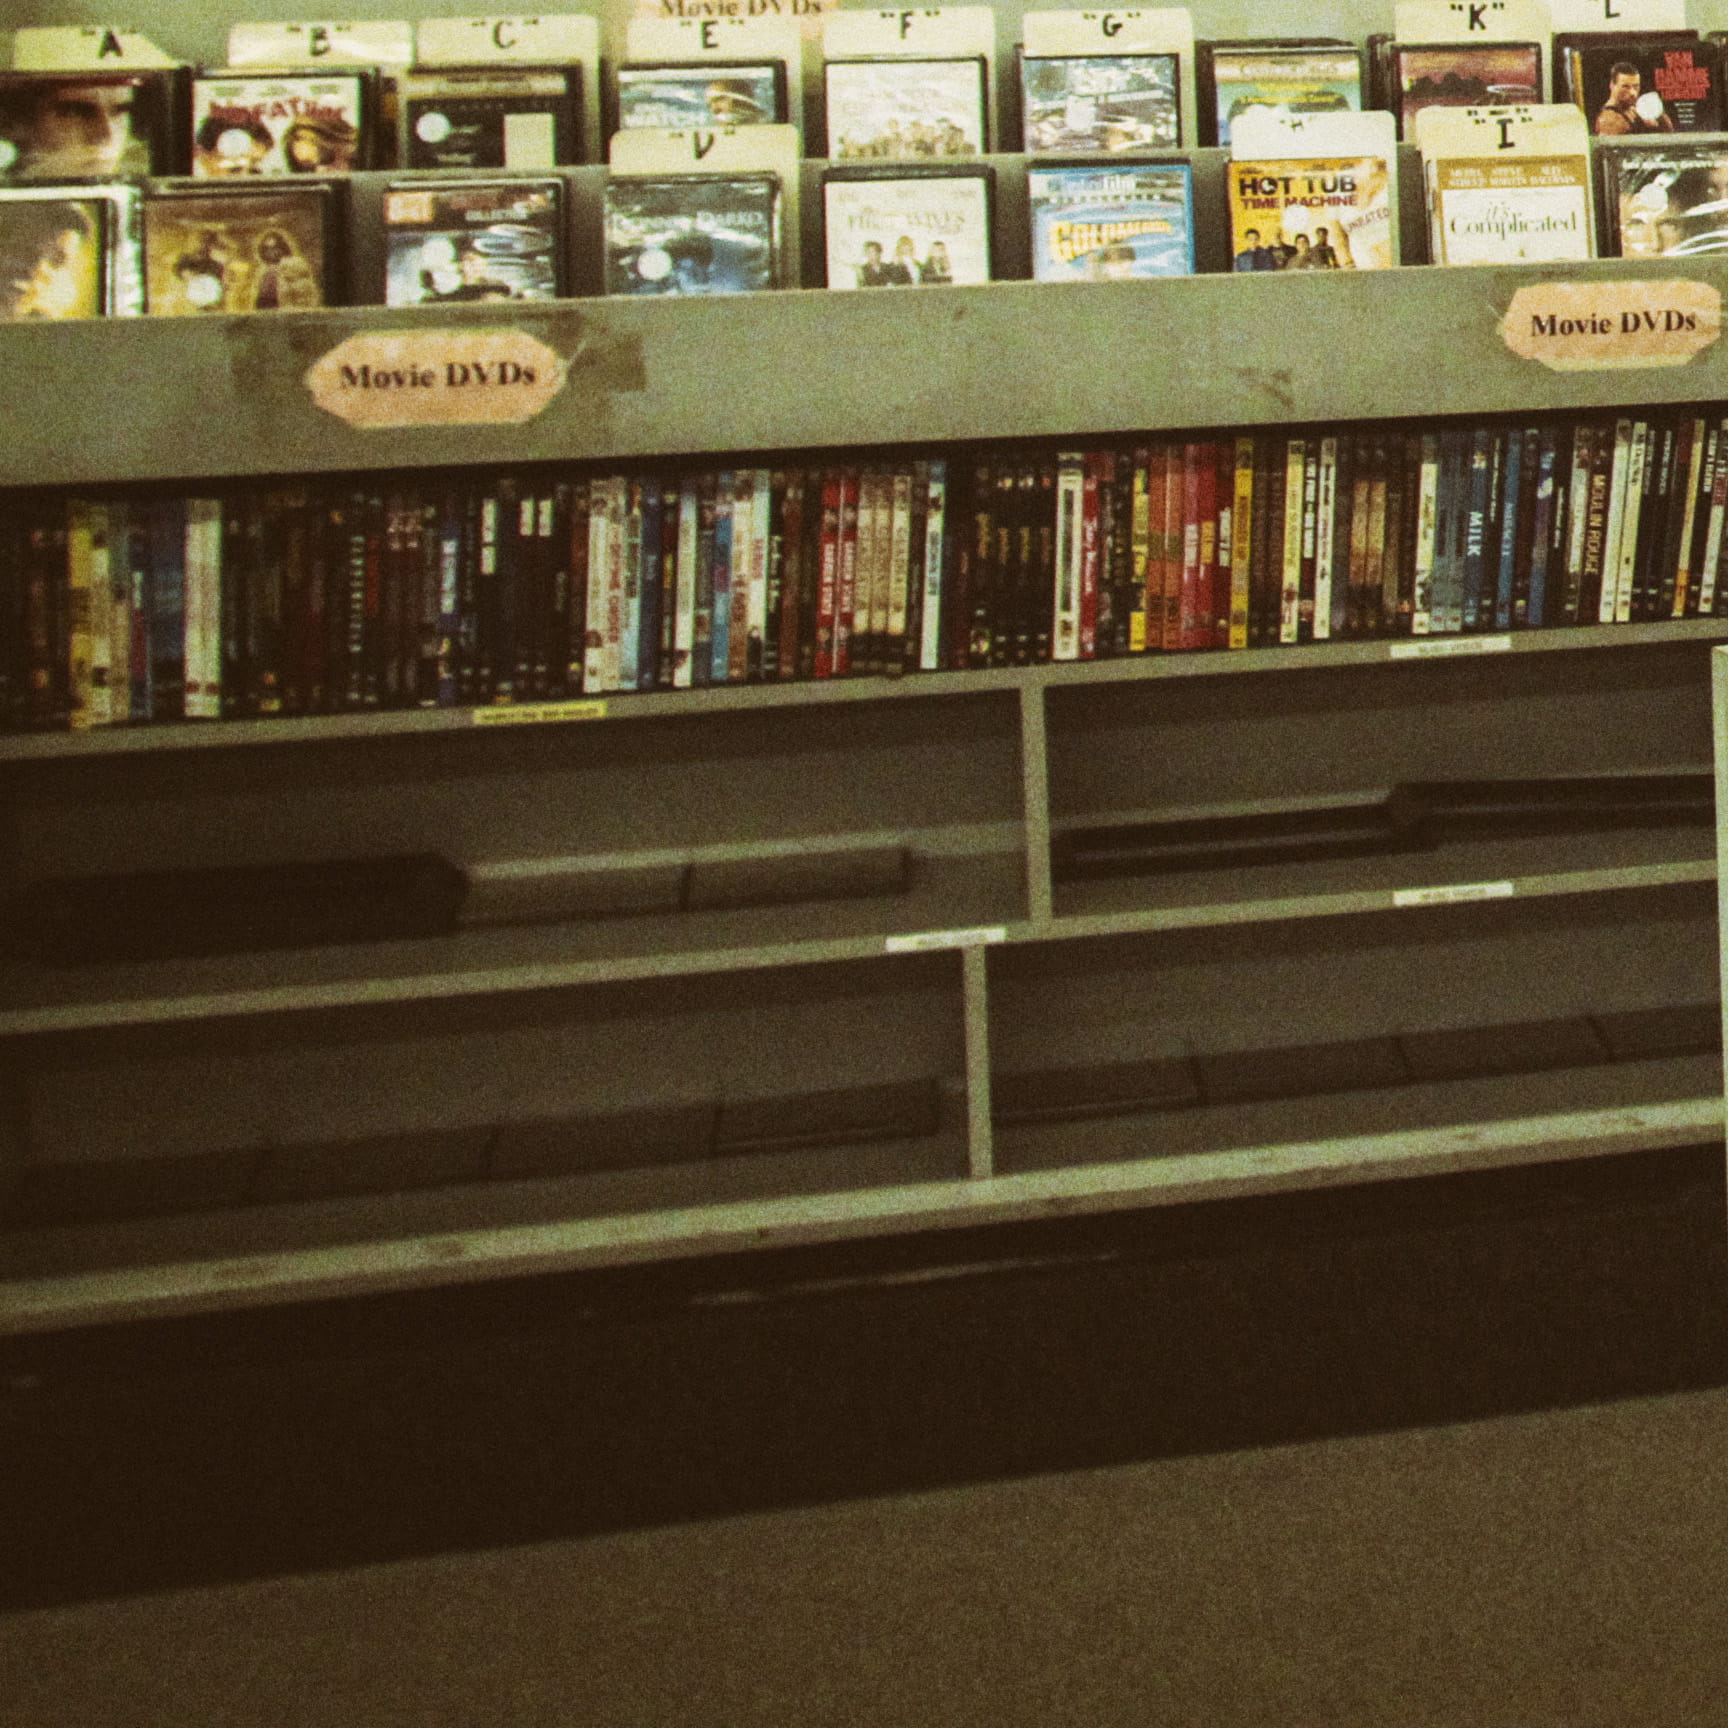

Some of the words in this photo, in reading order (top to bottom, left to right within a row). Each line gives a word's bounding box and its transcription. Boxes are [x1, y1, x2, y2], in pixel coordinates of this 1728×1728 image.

[1238, 176, 1295, 198] HOT
[1303, 176, 1357, 196] TUB
[1240, 193, 1280, 211] TIME
[1285, 191, 1359, 210] MACHINE
[1450, 209, 1577, 245] Complicated
[1530, 313, 1612, 338] Movie
[1619, 309, 1697, 336] DVDs
[340, 365, 435, 389] Movie
[446, 363, 537, 389] DVDs
[1589, 474, 1607, 527] MOULIN
[1467, 511, 1483, 557] MILK
[1585, 529, 1603, 575] ROUGE
